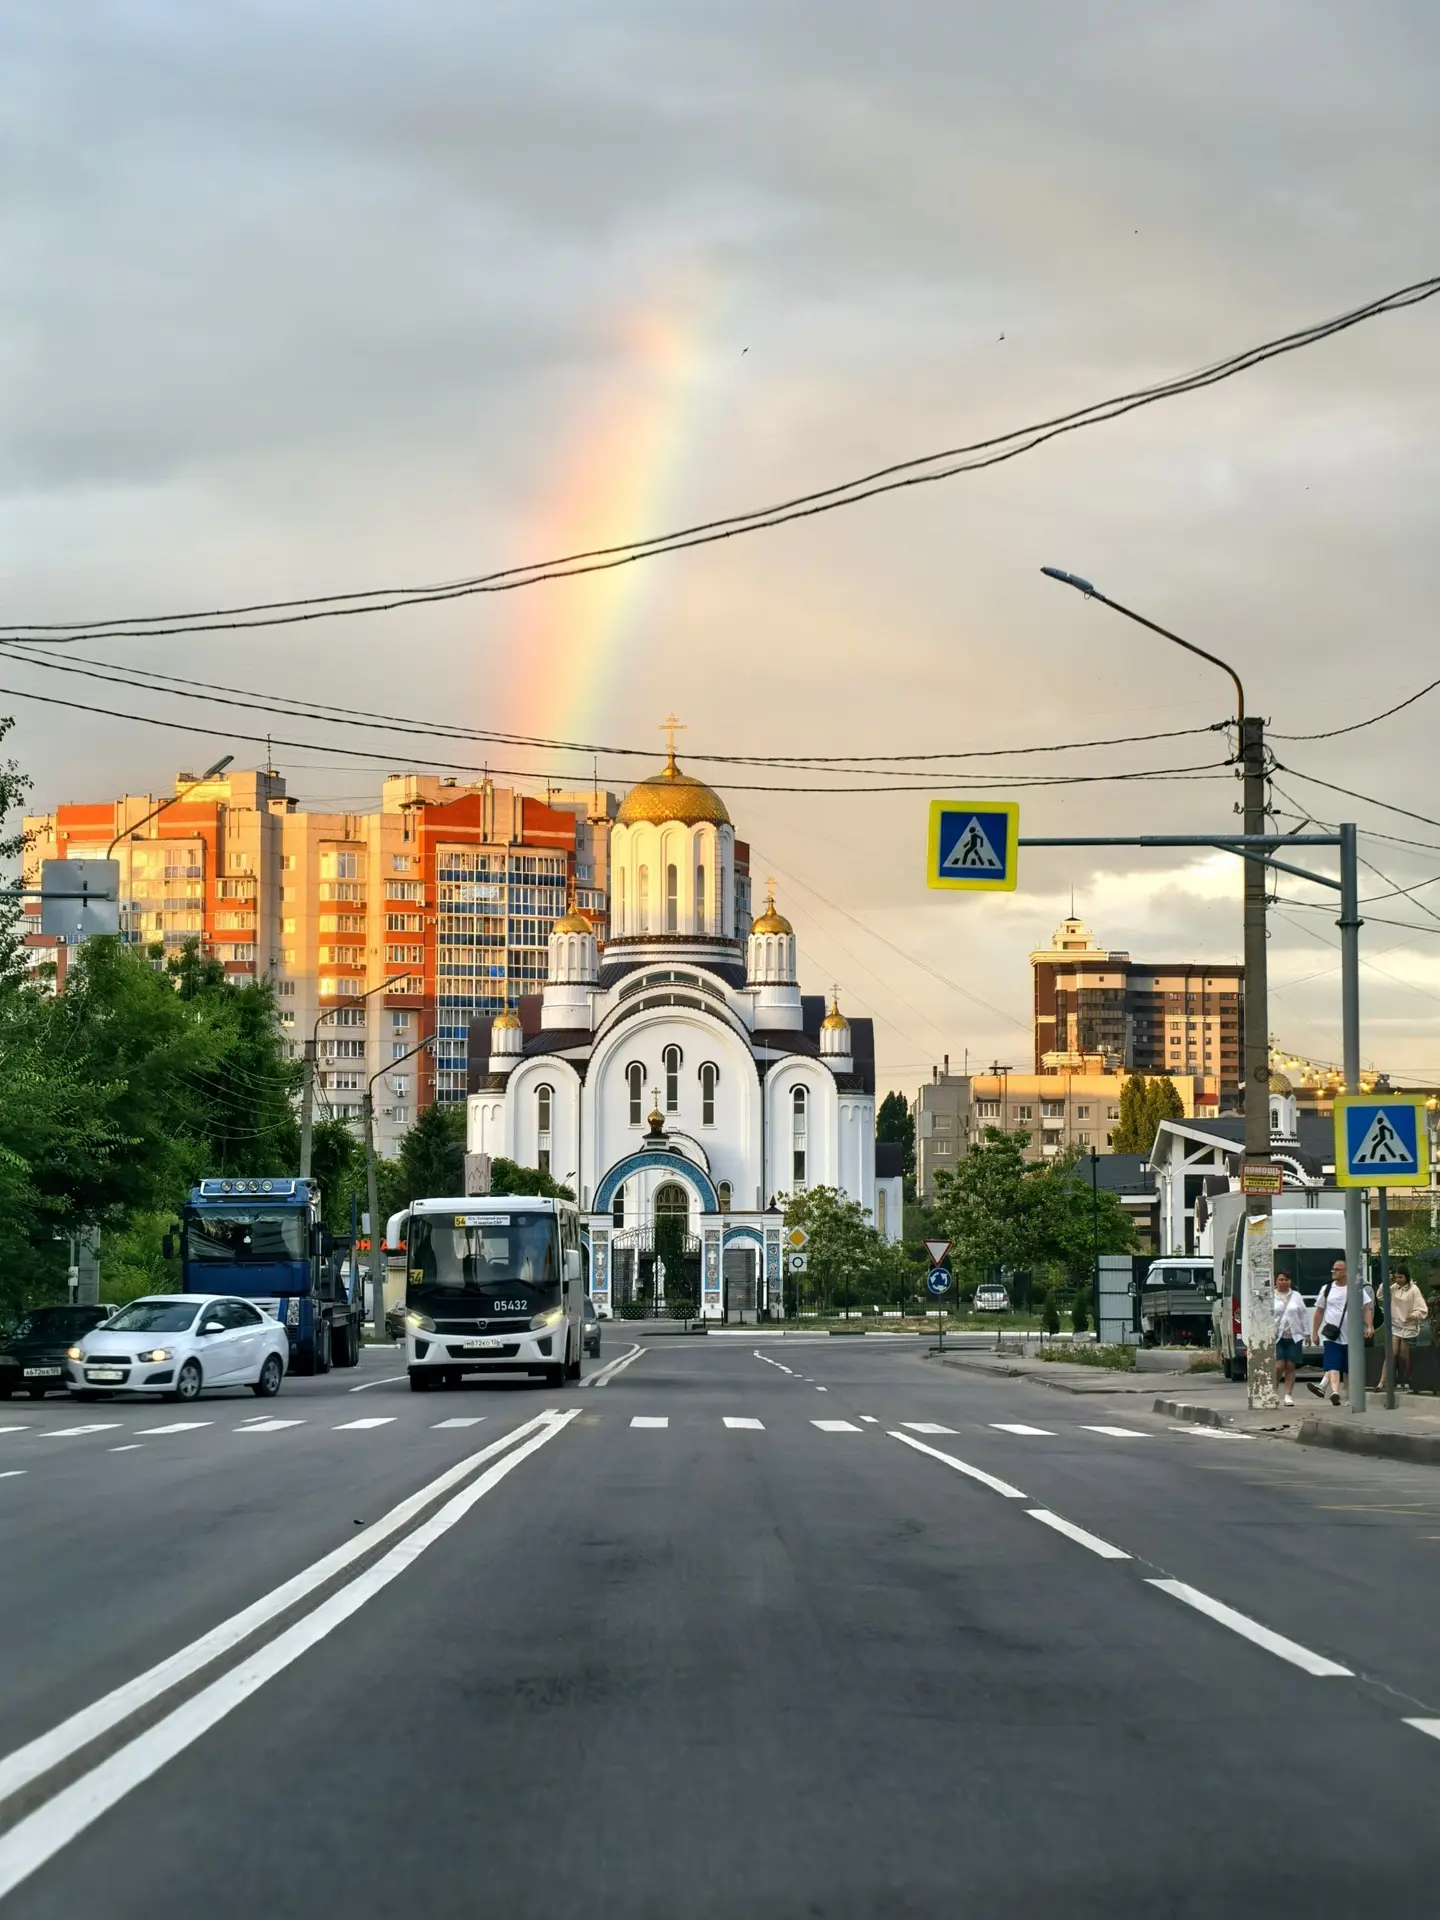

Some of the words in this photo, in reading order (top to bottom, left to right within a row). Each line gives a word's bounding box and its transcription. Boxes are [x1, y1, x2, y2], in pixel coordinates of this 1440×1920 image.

[1244, 1166, 1281, 1175] ПОМОЩЬ
[455, 1217, 466, 1225] 54
[410, 1271, 422, 1284] 54
[494, 1300, 528, 1311] 05432
